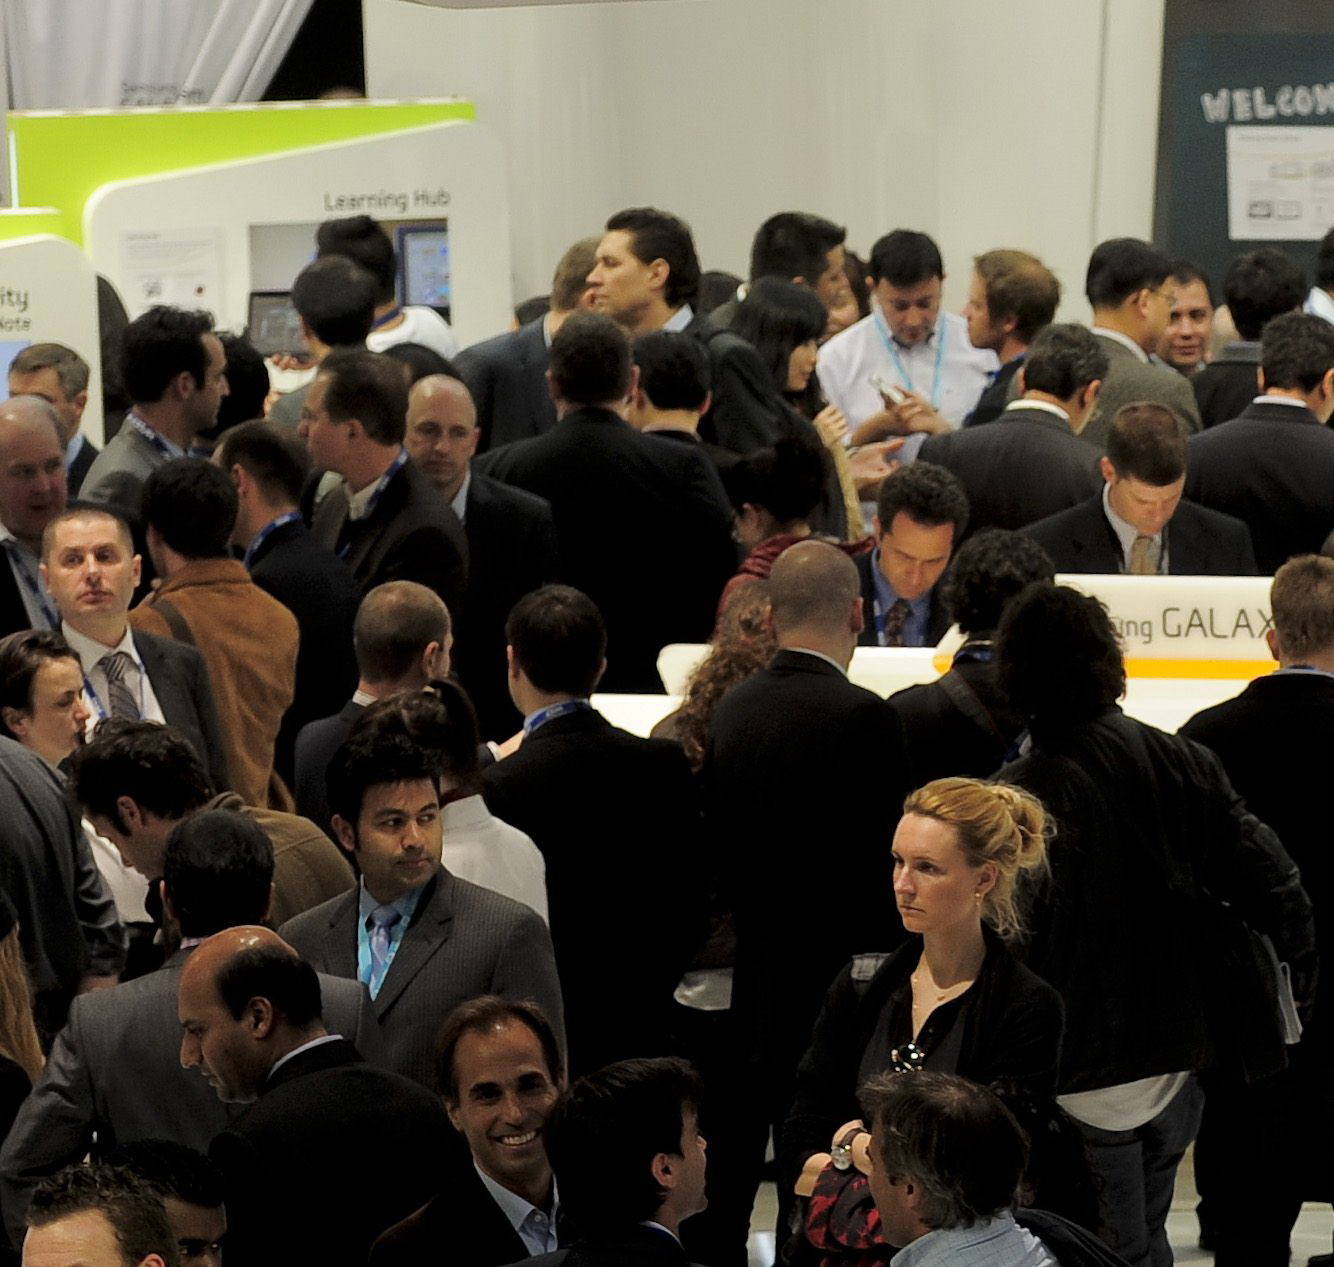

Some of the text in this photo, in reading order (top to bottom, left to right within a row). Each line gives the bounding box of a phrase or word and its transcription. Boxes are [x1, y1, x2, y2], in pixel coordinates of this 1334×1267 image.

[323, 186, 451, 213] Learning Hub
[1162, 607, 1275, 639] GALAX
